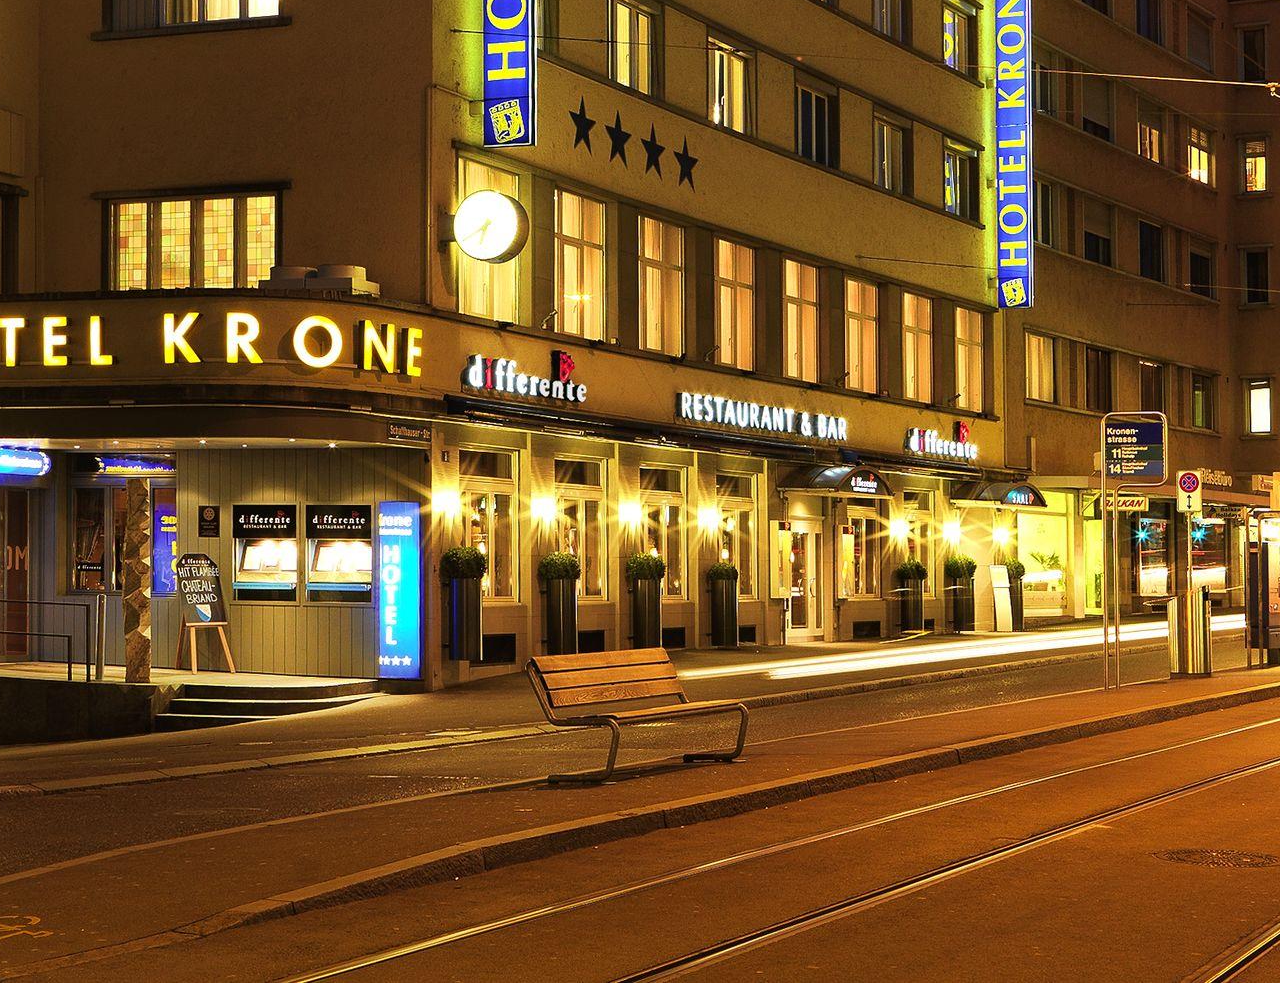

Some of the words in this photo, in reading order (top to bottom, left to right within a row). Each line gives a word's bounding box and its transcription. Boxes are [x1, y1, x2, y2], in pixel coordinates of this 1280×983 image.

[999, 130, 1028, 267] HOTEL
[164, 311, 423, 378] KRONE
[469, 353, 588, 403] differente
[680, 391, 795, 433] RESTAURANT
[800, 411, 812, 437] &
[817, 413, 848, 441] BAR
[1106, 427, 1139, 435] Kronen-
[909, 427, 978, 460] differente
[1111, 448, 1121, 459] 11
[1108, 463, 1122, 474] 14
[239, 515, 291, 524] differente
[312, 515, 366, 524] differente
[178, 566, 191, 578] HIT
[193, 566, 220, 578] FLAMBÉE
[180, 580, 216, 593] CHATEAU-
[186, 593, 218, 605] BRIAND
[382, 544, 401, 646] HOTEL
